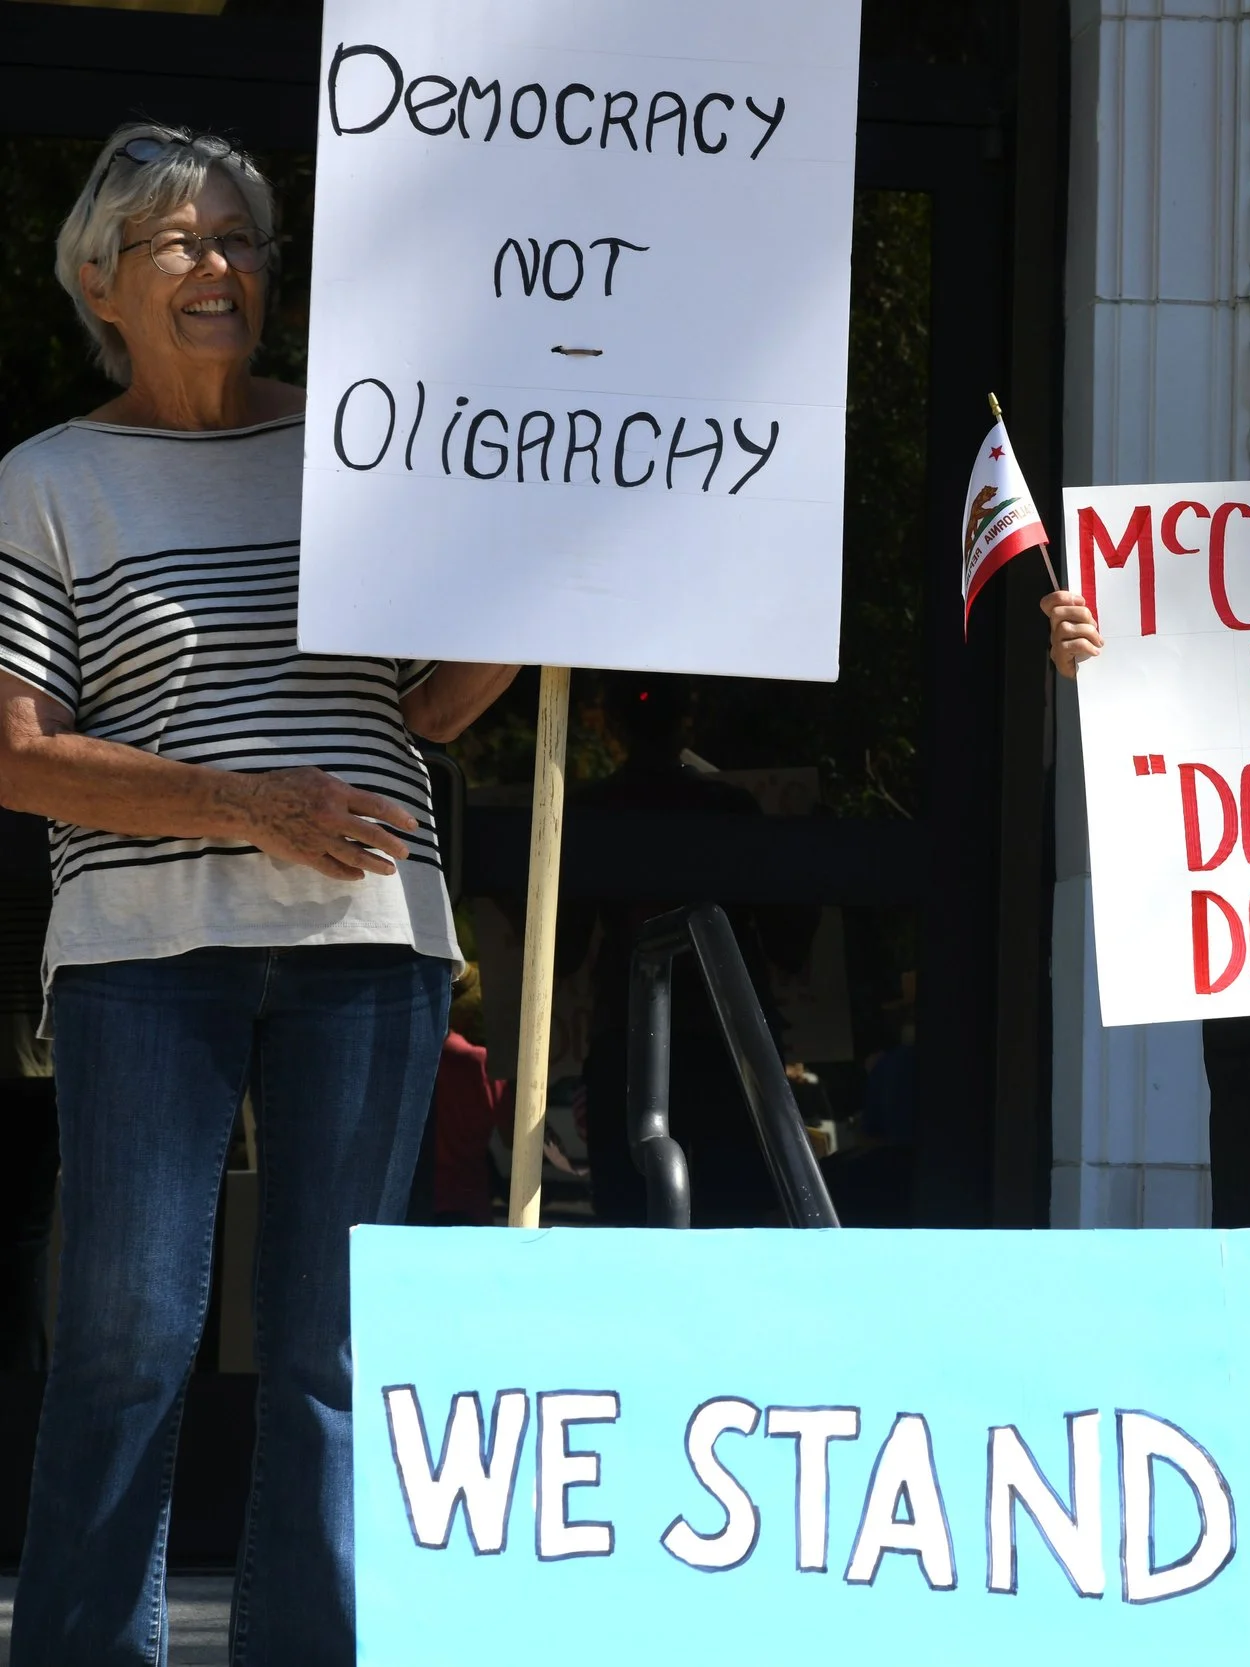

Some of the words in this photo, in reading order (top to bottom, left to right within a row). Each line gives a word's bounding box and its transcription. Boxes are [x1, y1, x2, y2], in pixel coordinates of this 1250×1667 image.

[495, 237, 650, 302] NOT
[382, 1384, 620, 1562] WE
[660, 1396, 1237, 1605] STAND
